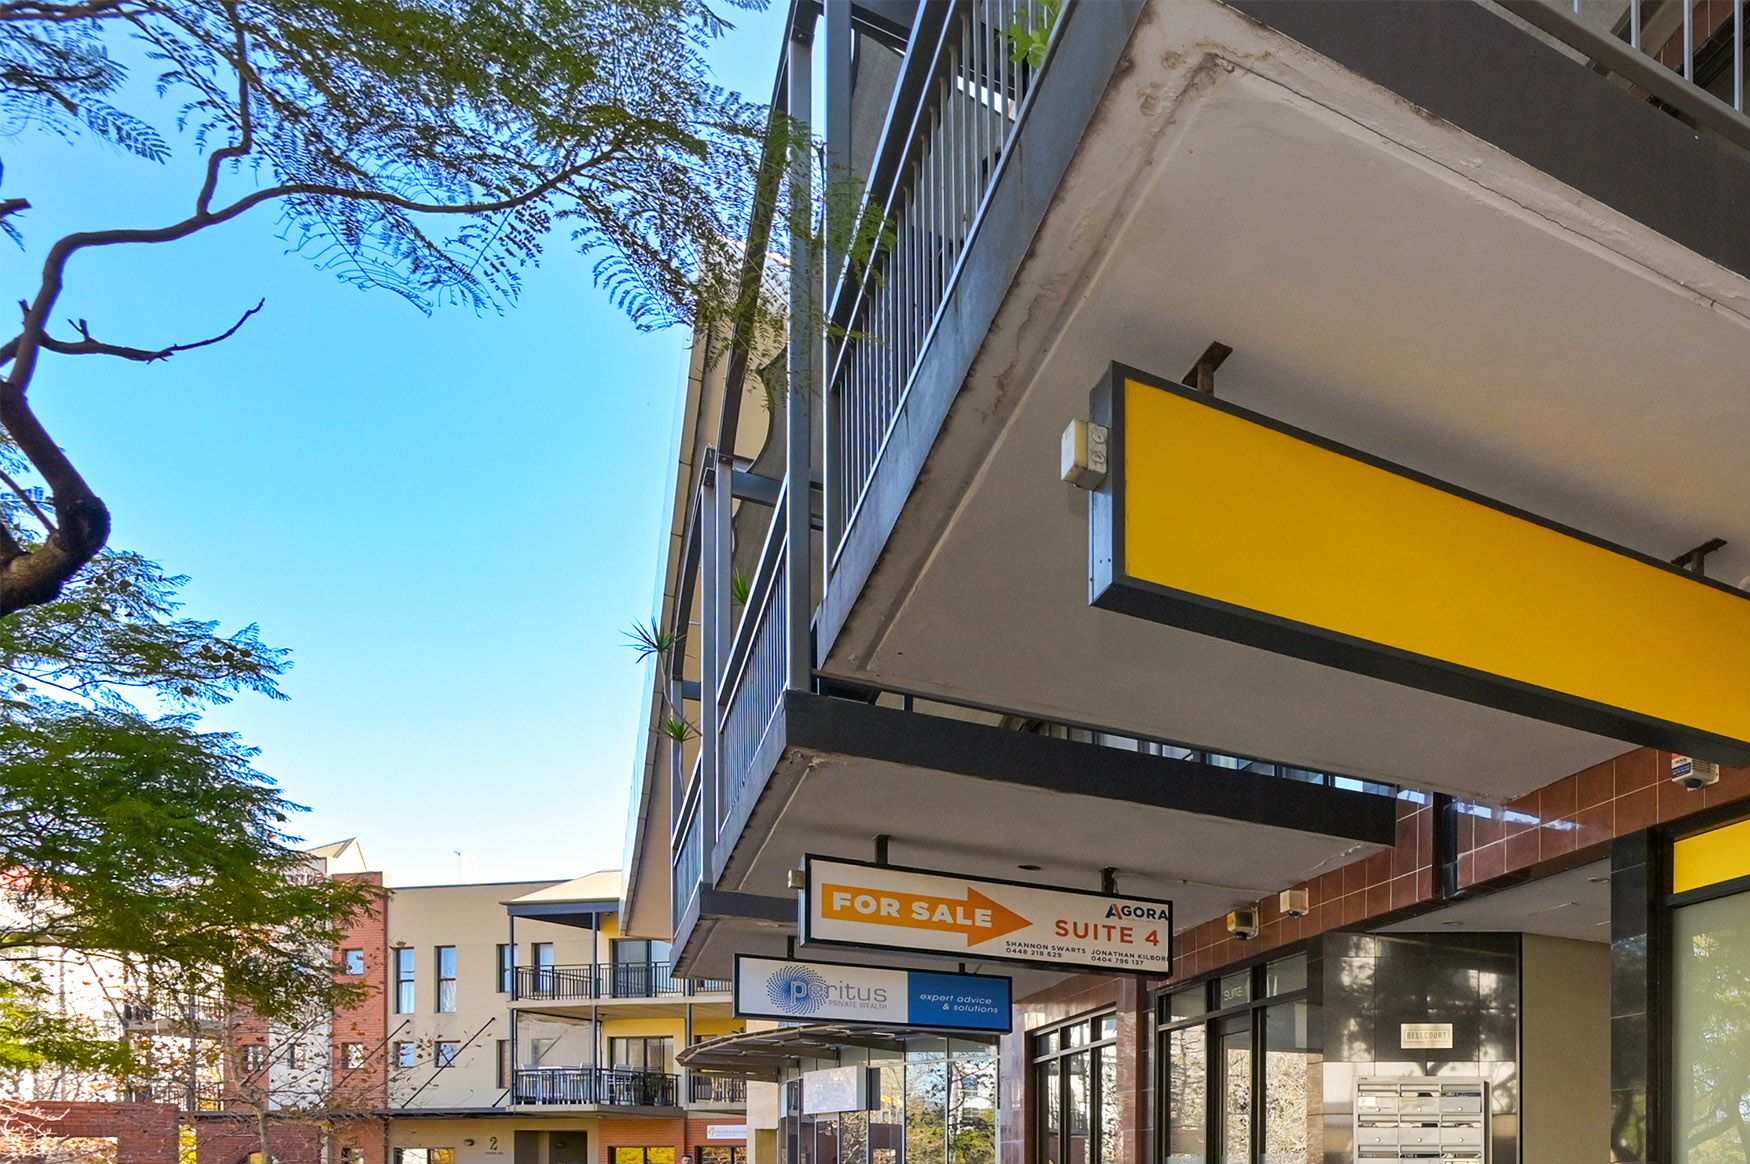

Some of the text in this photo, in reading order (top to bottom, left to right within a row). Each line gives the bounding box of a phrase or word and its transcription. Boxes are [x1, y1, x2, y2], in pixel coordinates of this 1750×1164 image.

[833, 891, 992, 928] FOR SALE
[1105, 903, 1169, 921] AGORA
[1055, 919, 1159, 946] SUITE 4
[1006, 941, 1086, 954] SHANNON SWARTS
[1006, 947, 1062, 959] 0448 218 629
[1091, 949, 1169, 963] JONATHAN KILBOR
[1091, 956, 1113, 964] 0404
[790, 980, 887, 1004] peritus
[829, 1000, 888, 1010] PRIVATE WEALTH
[920, 993, 993, 1005] expert advice
[953, 1004, 998, 1014] solutions
[1406, 1031, 1447, 1040] BELLCOURT
